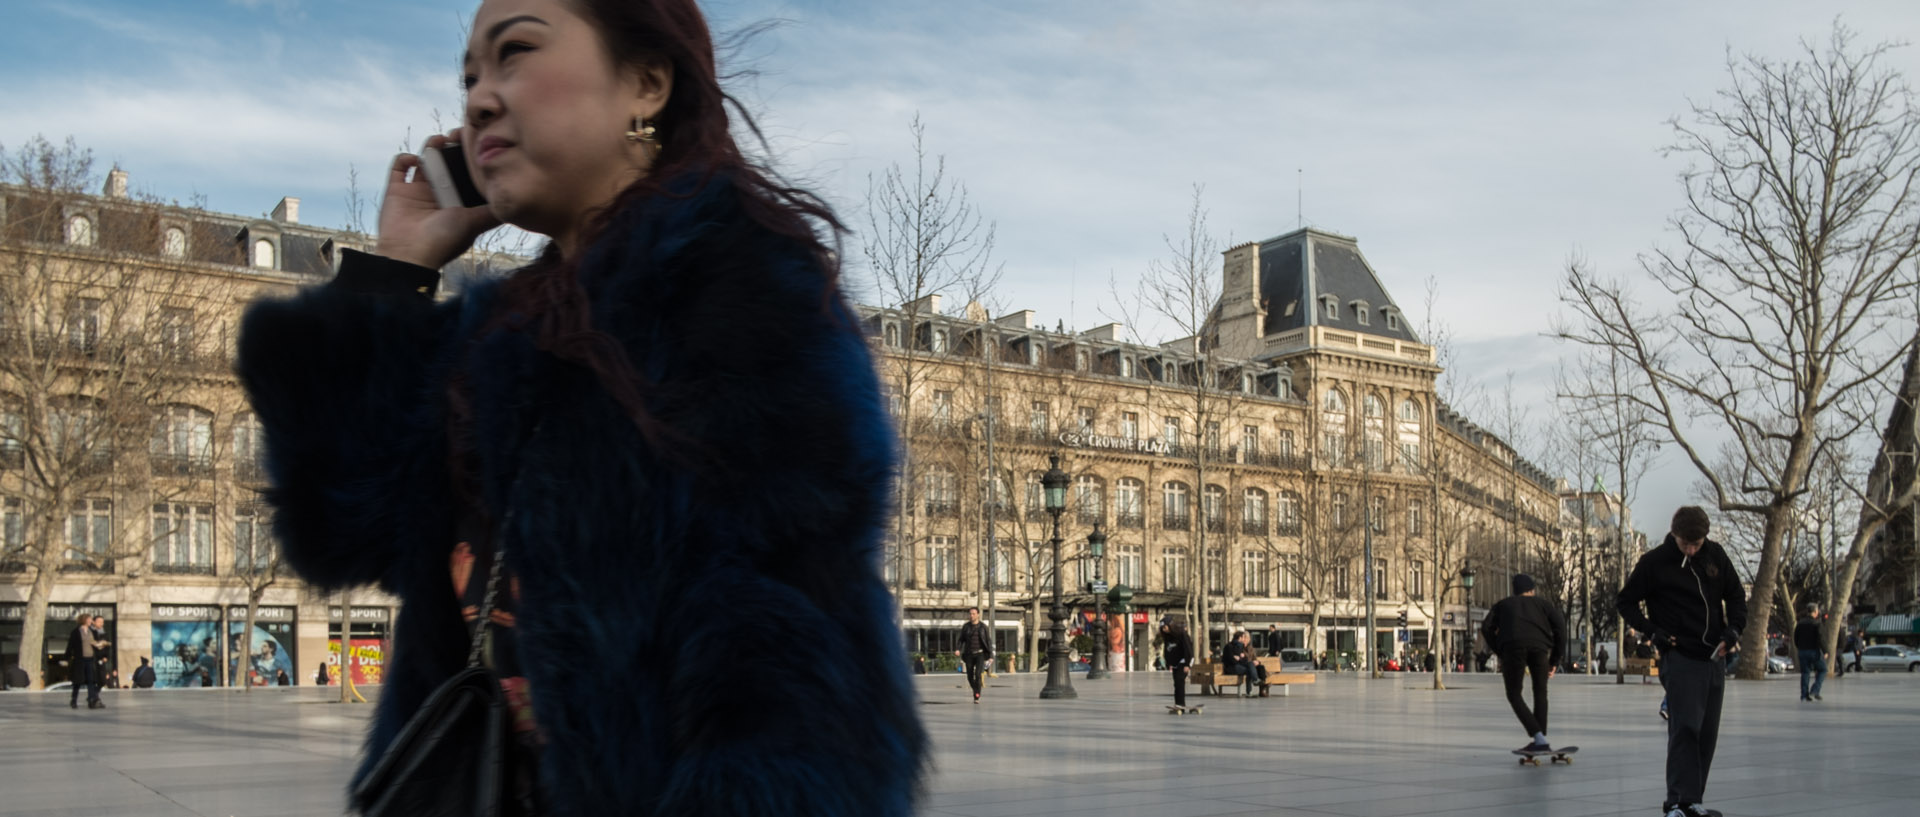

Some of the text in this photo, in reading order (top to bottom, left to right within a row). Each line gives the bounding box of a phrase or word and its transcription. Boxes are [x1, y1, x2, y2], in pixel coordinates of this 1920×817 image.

[1088, 434, 1171, 454] CROWNE PLAZA
[158, 606, 213, 617] GO SPORT
[231, 607, 285, 618] GO PORT
[350, 609, 382, 618] SPORT
[153, 655, 183, 669] PARIS
